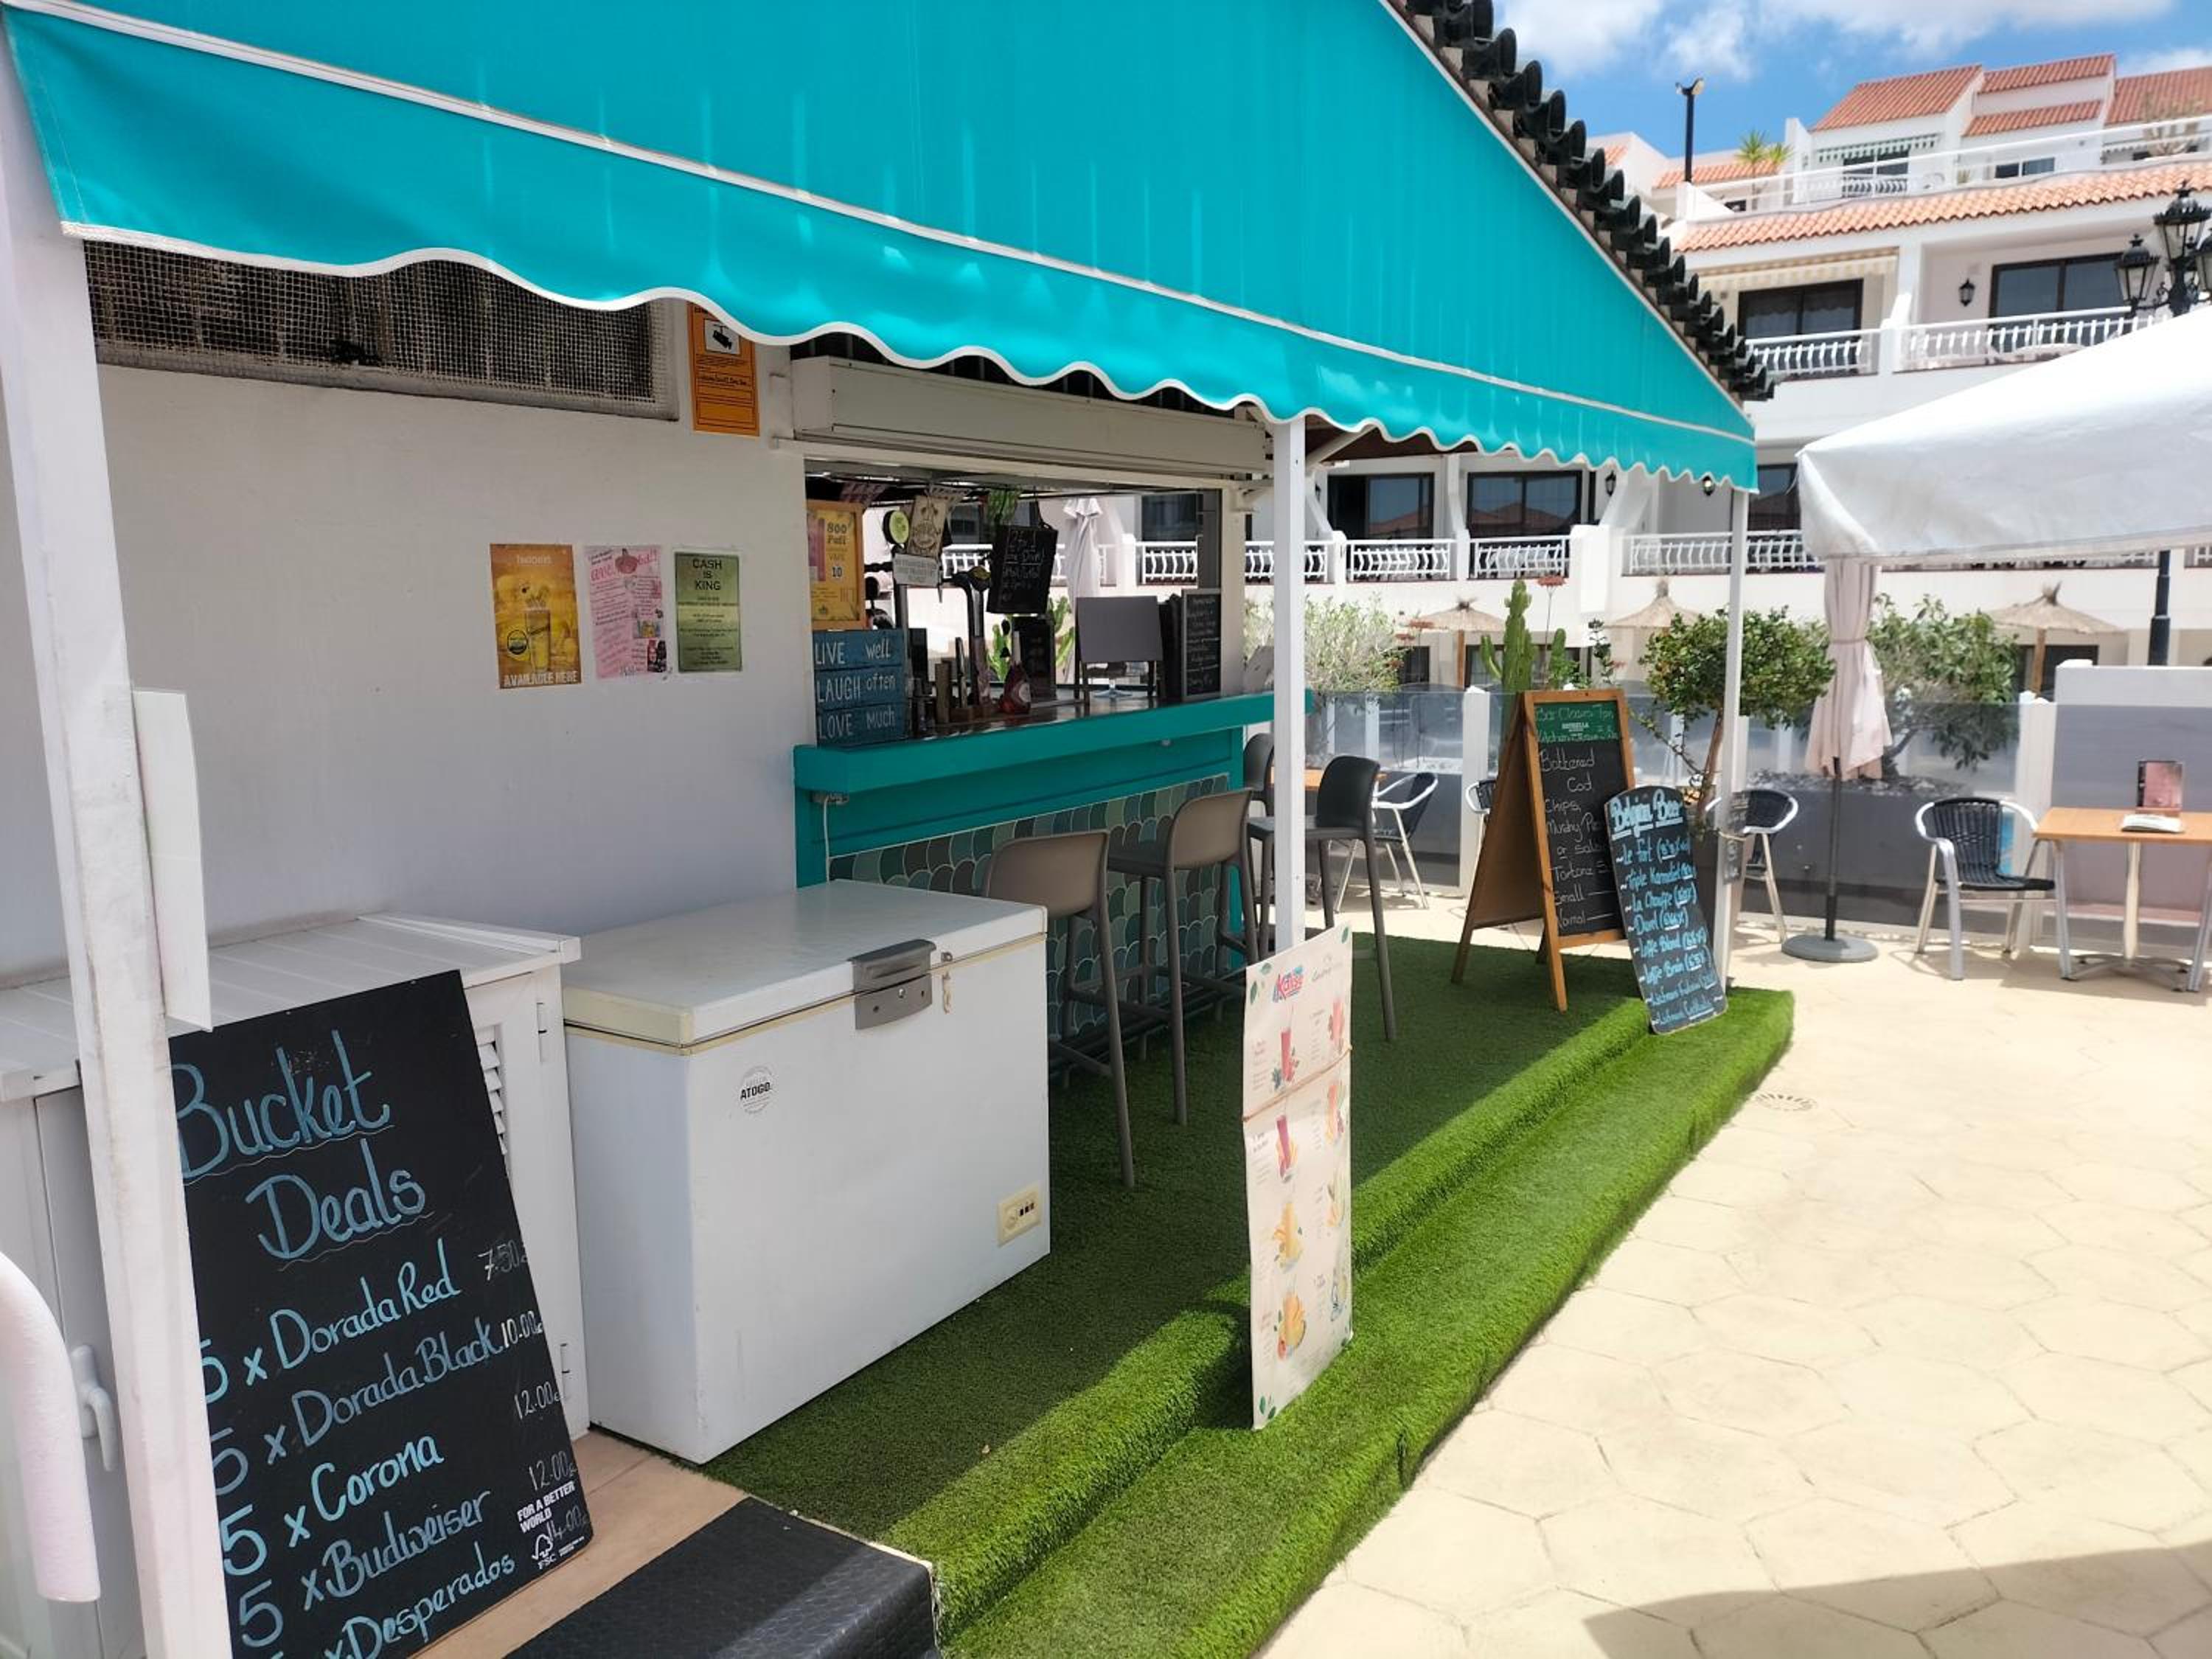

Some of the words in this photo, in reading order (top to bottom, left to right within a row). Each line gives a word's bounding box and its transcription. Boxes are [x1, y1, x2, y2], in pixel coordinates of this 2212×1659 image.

[692, 558, 723, 569] CASH
[703, 571, 712, 579] IS
[695, 581, 720, 591] KING
[815, 641, 846, 665] LIVE
[817, 676, 861, 703] LAUGH
[818, 713, 853, 740] LOVE
[171, 1029, 391, 1180] Bucket
[245, 1137, 426, 1259] Deals
[243, 1347, 268, 1386] x
[269, 1276, 400, 1370] Dorada
[397, 1238, 462, 1315] Red
[210, 1427, 249, 1496] 5
[264, 1425, 287, 1465] x
[291, 1352, 425, 1447] Dorada
[414, 1316, 504, 1383] Black
[220, 1504, 268, 1576] 5
[284, 1505, 310, 1548] x
[311, 1435, 445, 1521] Corona
[517, 1503, 536, 1521] FOR
[536, 1499, 543, 1511] A
[543, 1481, 576, 1506] BETTER
[520, 1507, 552, 1534] WORLD
[240, 1579, 284, 1648] 5
[301, 1569, 324, 1611] x
[322, 1490, 490, 1599] Budweiser
[341, 1541, 516, 1659] Desperados
